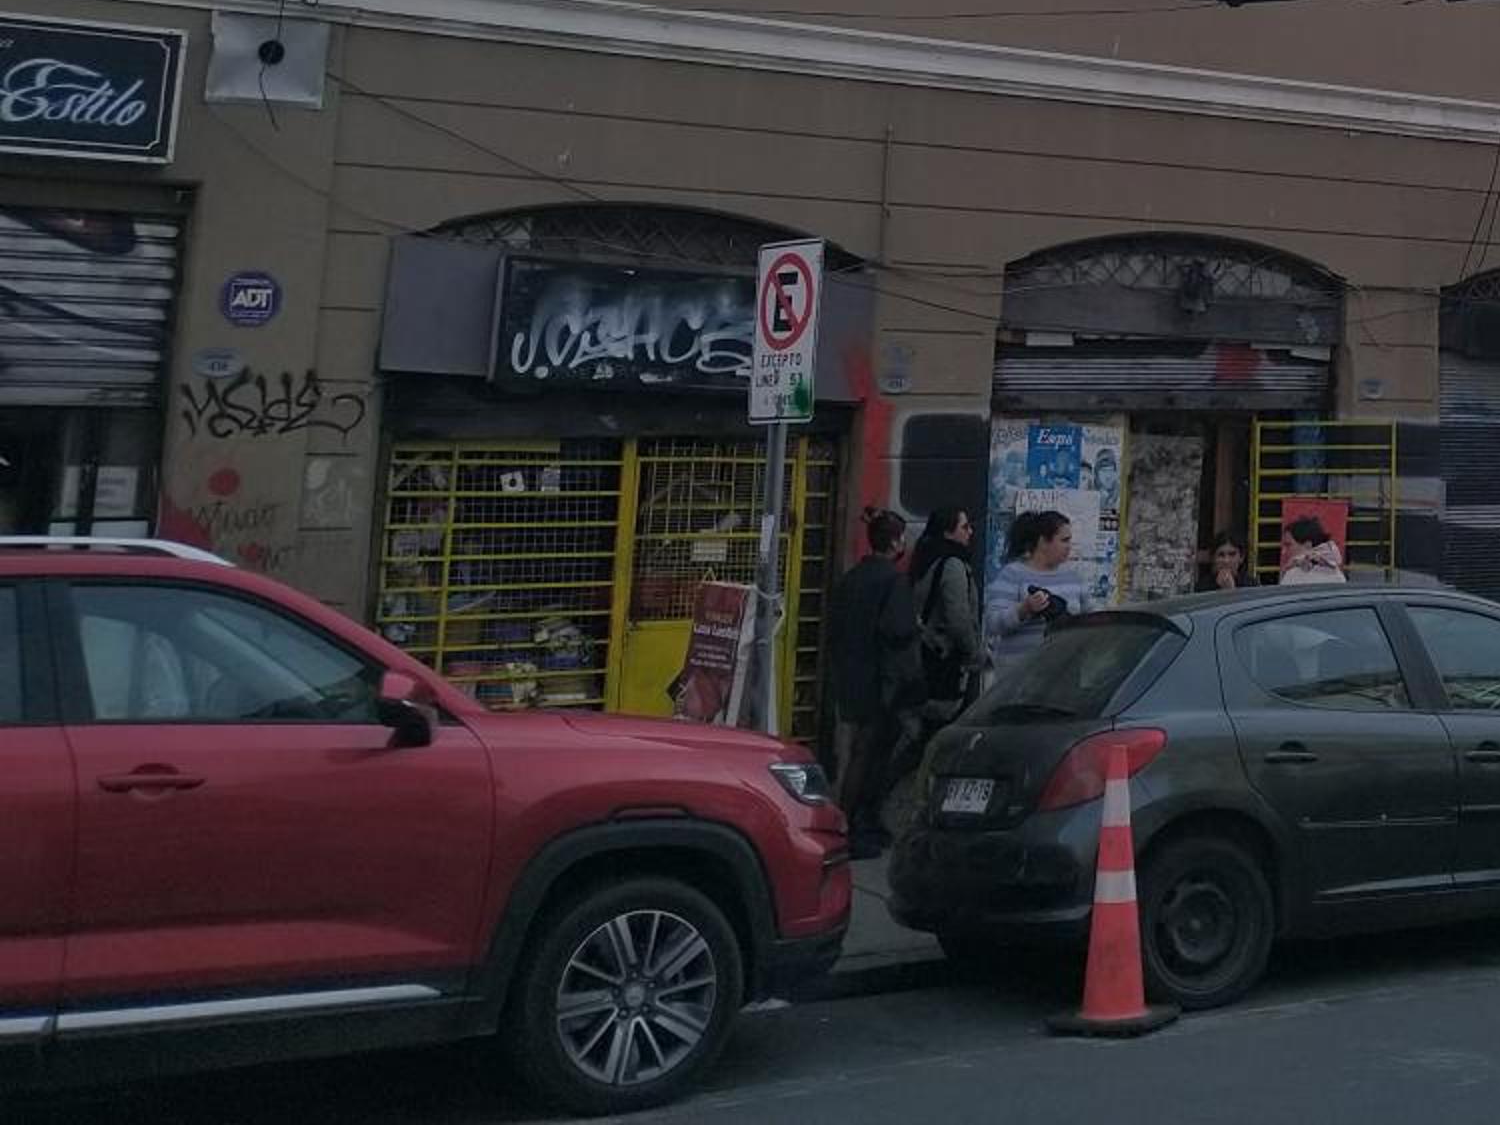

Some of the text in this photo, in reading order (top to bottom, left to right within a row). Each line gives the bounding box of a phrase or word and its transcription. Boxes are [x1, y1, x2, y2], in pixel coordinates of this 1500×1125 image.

[0, 58, 147, 126] Estilo
[230, 288, 272, 308] ADT
[761, 353, 802, 368] EXCEPTO
